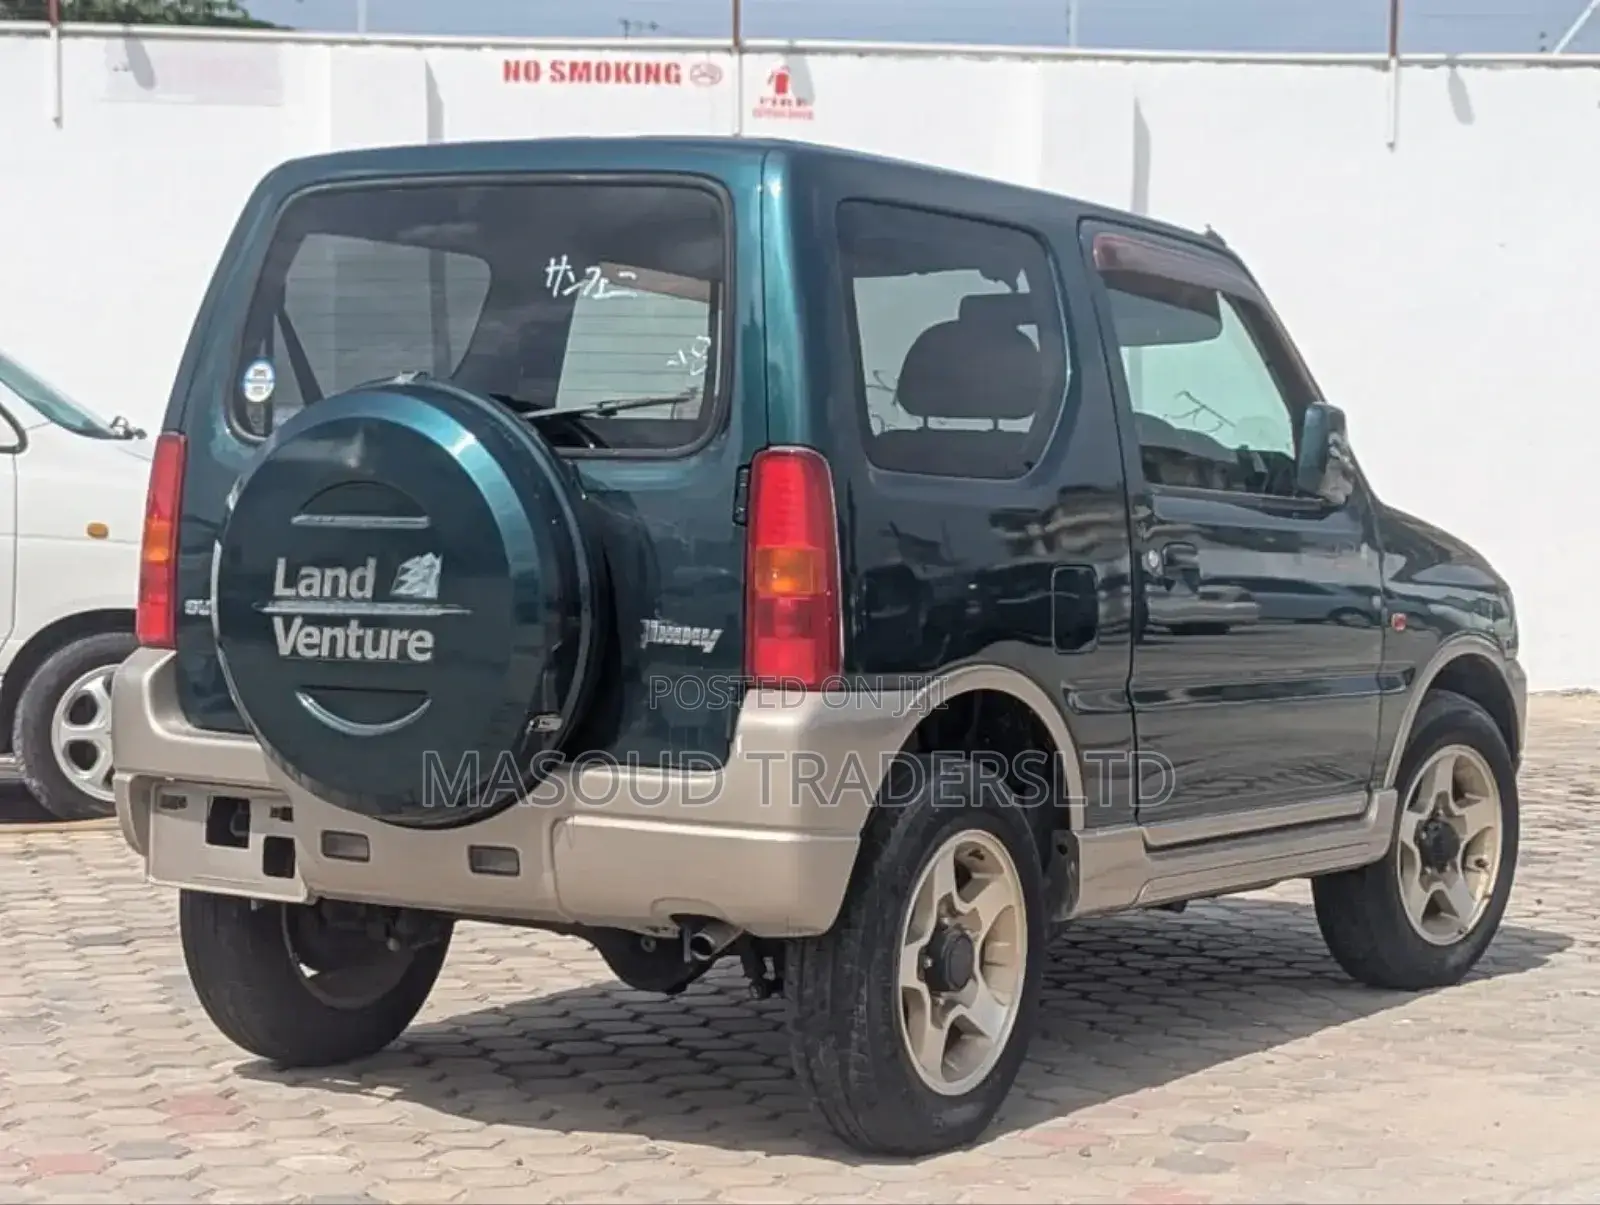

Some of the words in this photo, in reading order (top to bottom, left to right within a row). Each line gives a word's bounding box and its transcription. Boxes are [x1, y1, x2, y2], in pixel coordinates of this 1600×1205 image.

[503, 59, 541, 83] NO
[549, 60, 682, 85] SMOKING
[273, 556, 378, 598] Land
[272, 615, 435, 662] Venture
